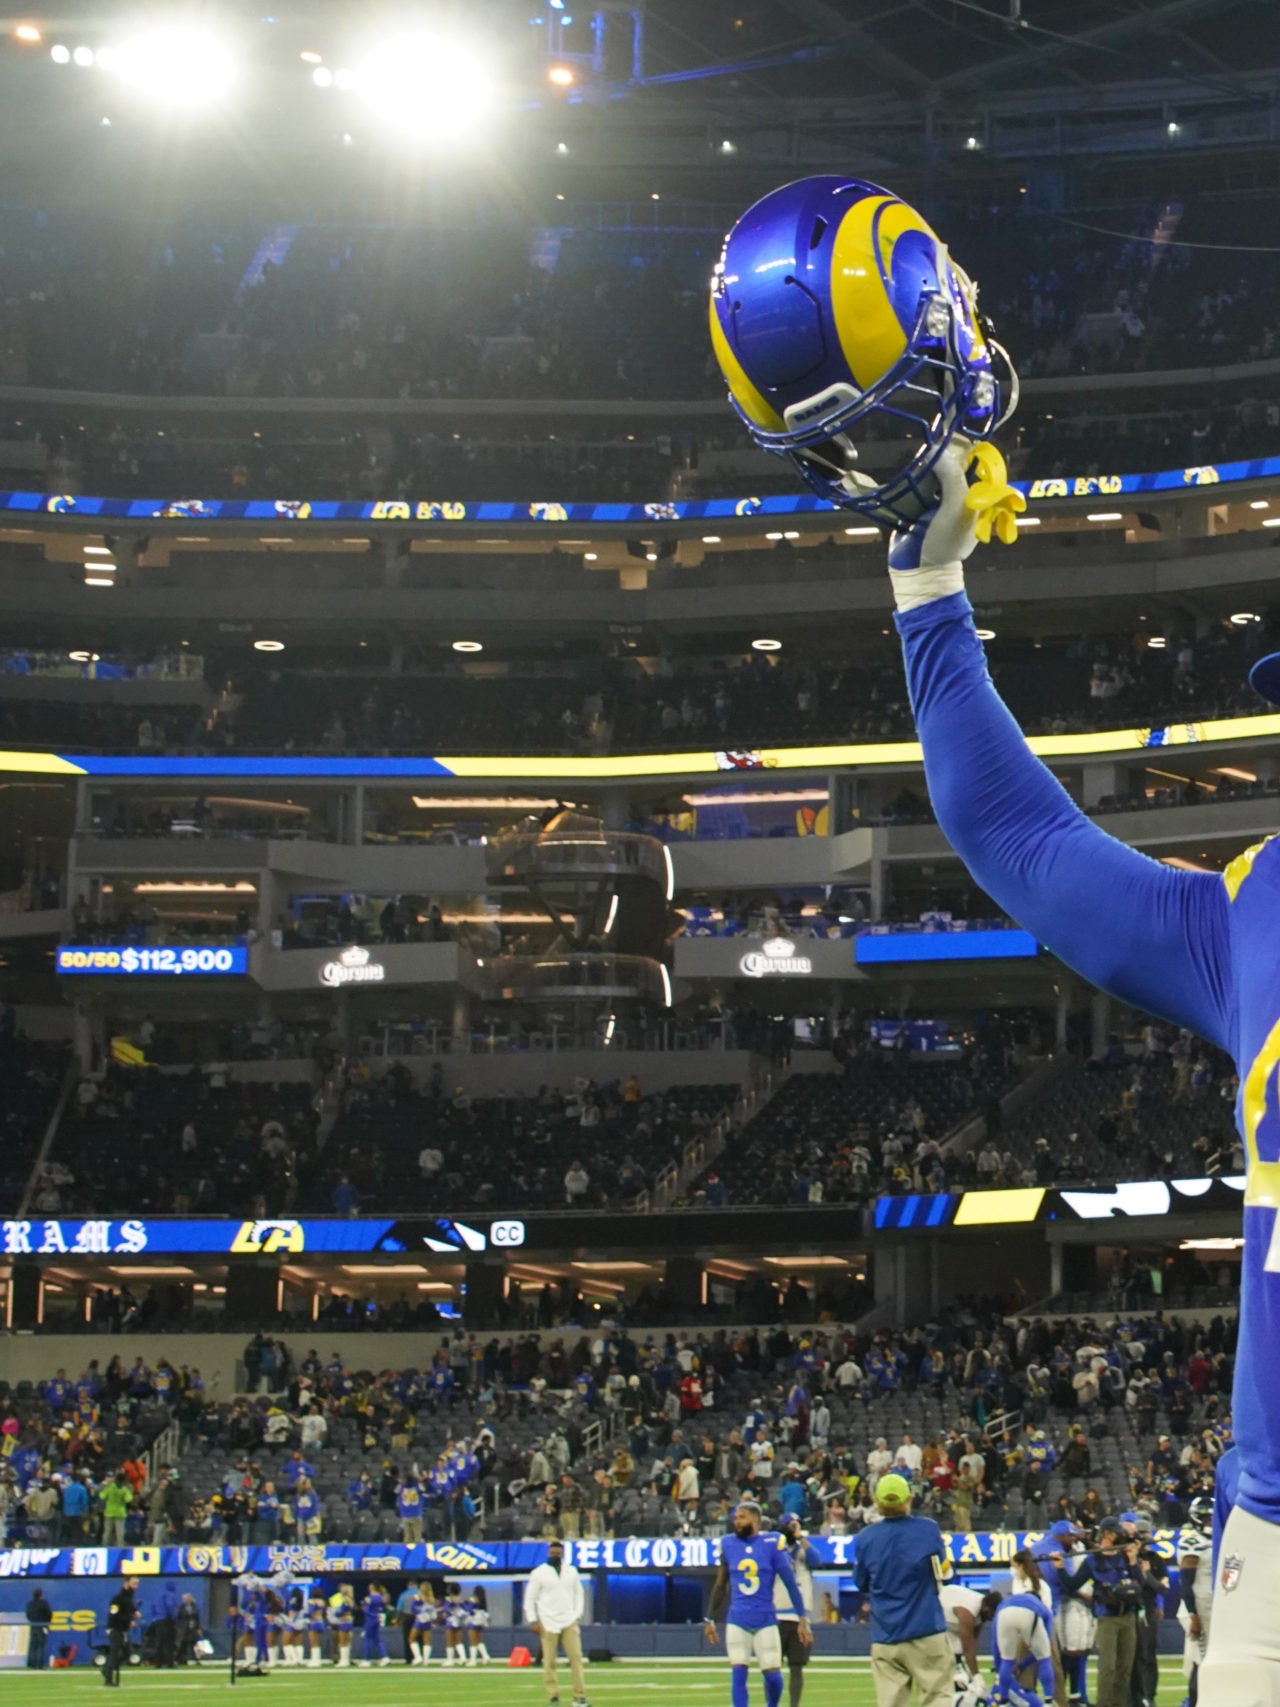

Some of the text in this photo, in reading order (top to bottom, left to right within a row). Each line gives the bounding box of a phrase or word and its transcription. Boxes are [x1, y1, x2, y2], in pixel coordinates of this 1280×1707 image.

[60, 947, 232, 974] 50/50 $112,900
[3, 1220, 148, 1253] RAMS
[827, 1535, 856, 1564] T
[737, 1558, 760, 1595] 3
